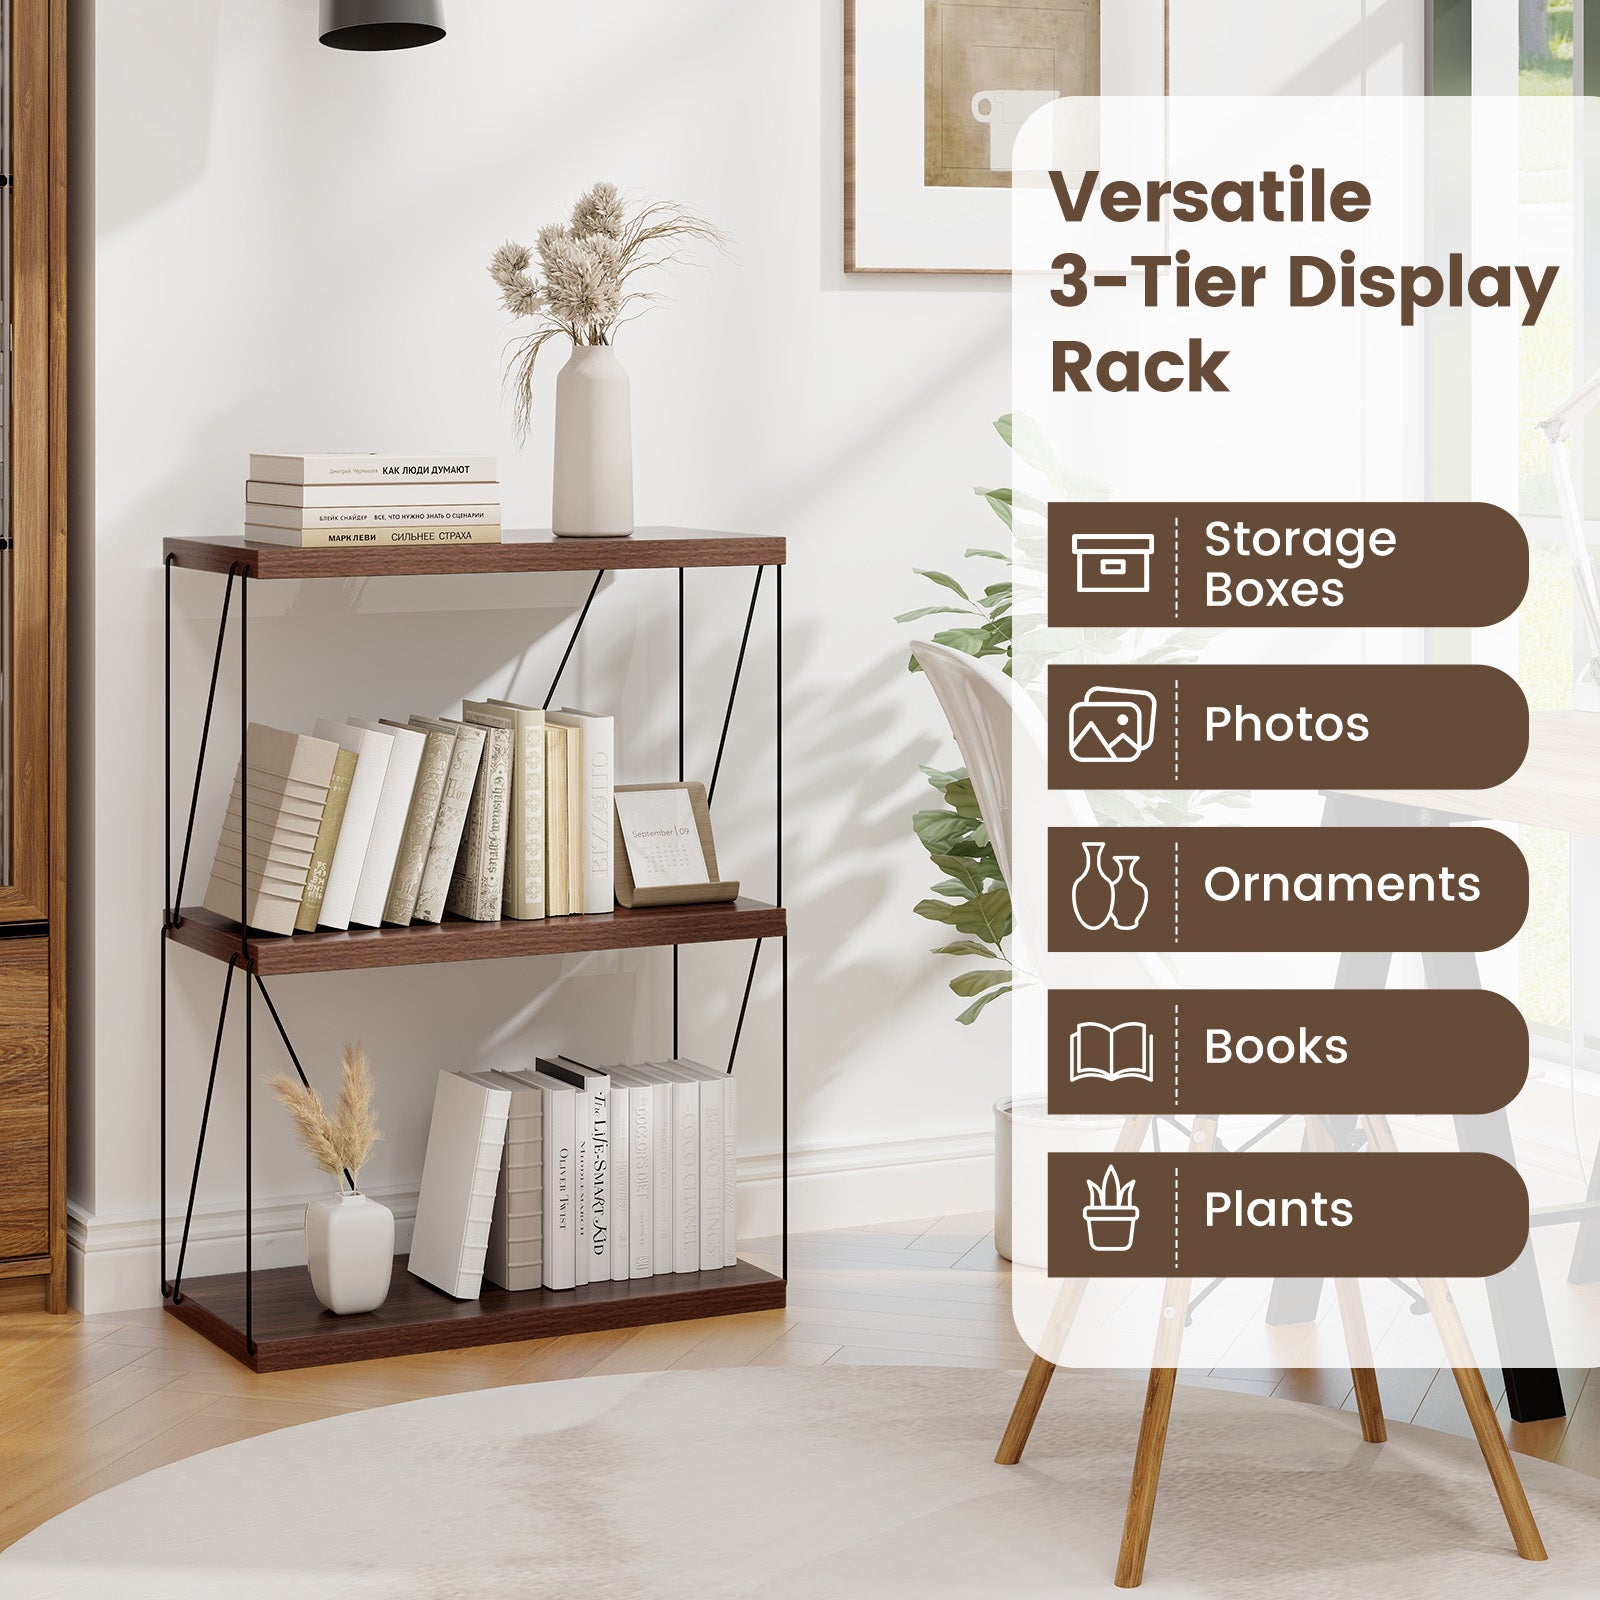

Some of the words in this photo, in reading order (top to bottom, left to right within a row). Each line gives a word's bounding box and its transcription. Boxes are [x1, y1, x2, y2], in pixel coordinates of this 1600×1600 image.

[382, 466, 401, 475] КАК
[402, 465, 430, 475] ЛЮДИ
[431, 465, 470, 476] ДУМАЮТ
[374, 513, 387, 521] ВСЕ,
[452, 512, 485, 520] СЦЕНАРИИ
[328, 534, 352, 542] МАРК
[353, 534, 377, 542] ЛЕВИ
[391, 532, 435, 541] СИЛЬНЕЕ
[438, 531, 472, 541] СТРАХА
[632, 829, 674, 838] September
[679, 827, 690, 835] 09
